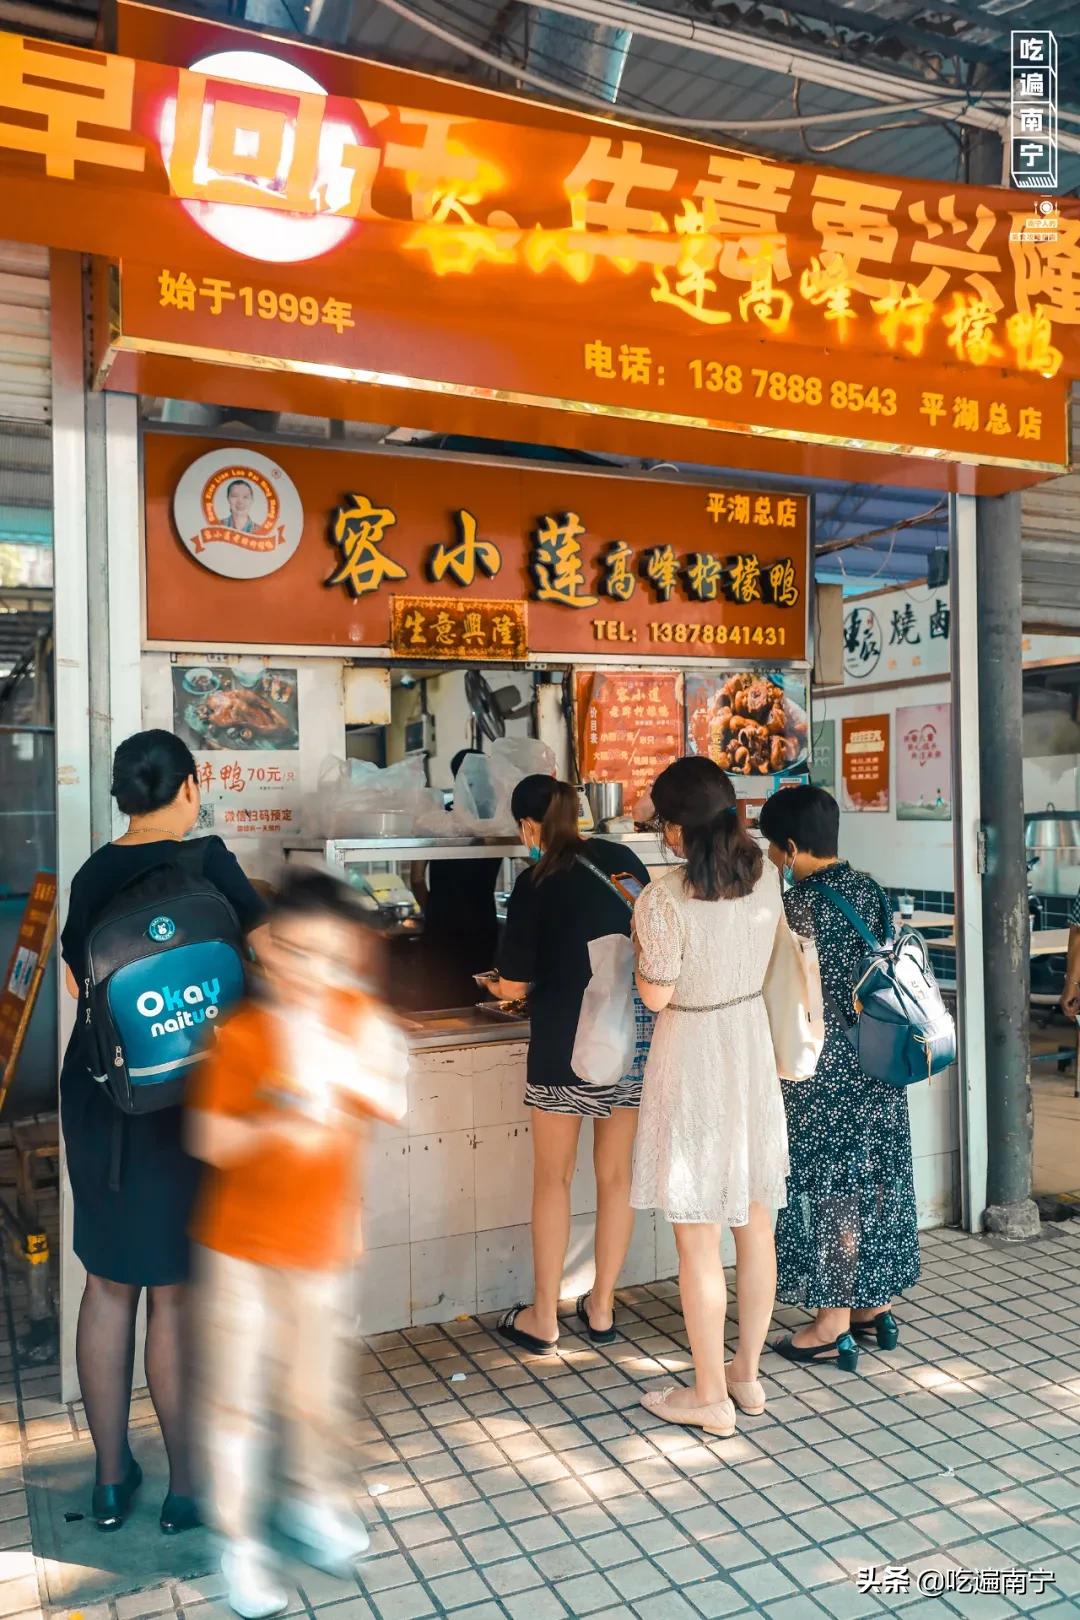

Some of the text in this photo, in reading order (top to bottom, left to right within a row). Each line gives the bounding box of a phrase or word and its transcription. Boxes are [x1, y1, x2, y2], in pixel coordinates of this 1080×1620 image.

[158, 269, 356, 334] 始于1999年
[688, 359, 742, 394] 138
[752, 367, 824, 407] 7888
[830, 381, 897, 416] 8543
[918, 391, 1043, 440] 平湖总店
[707, 493, 797, 528] 平湖总店
[404, 610, 516, 646] 生意興隆
[593, 619, 786, 646] TEL: 13878841431
[136, 977, 221, 1017] Okay
[150, 1005, 219, 1038] naituo
